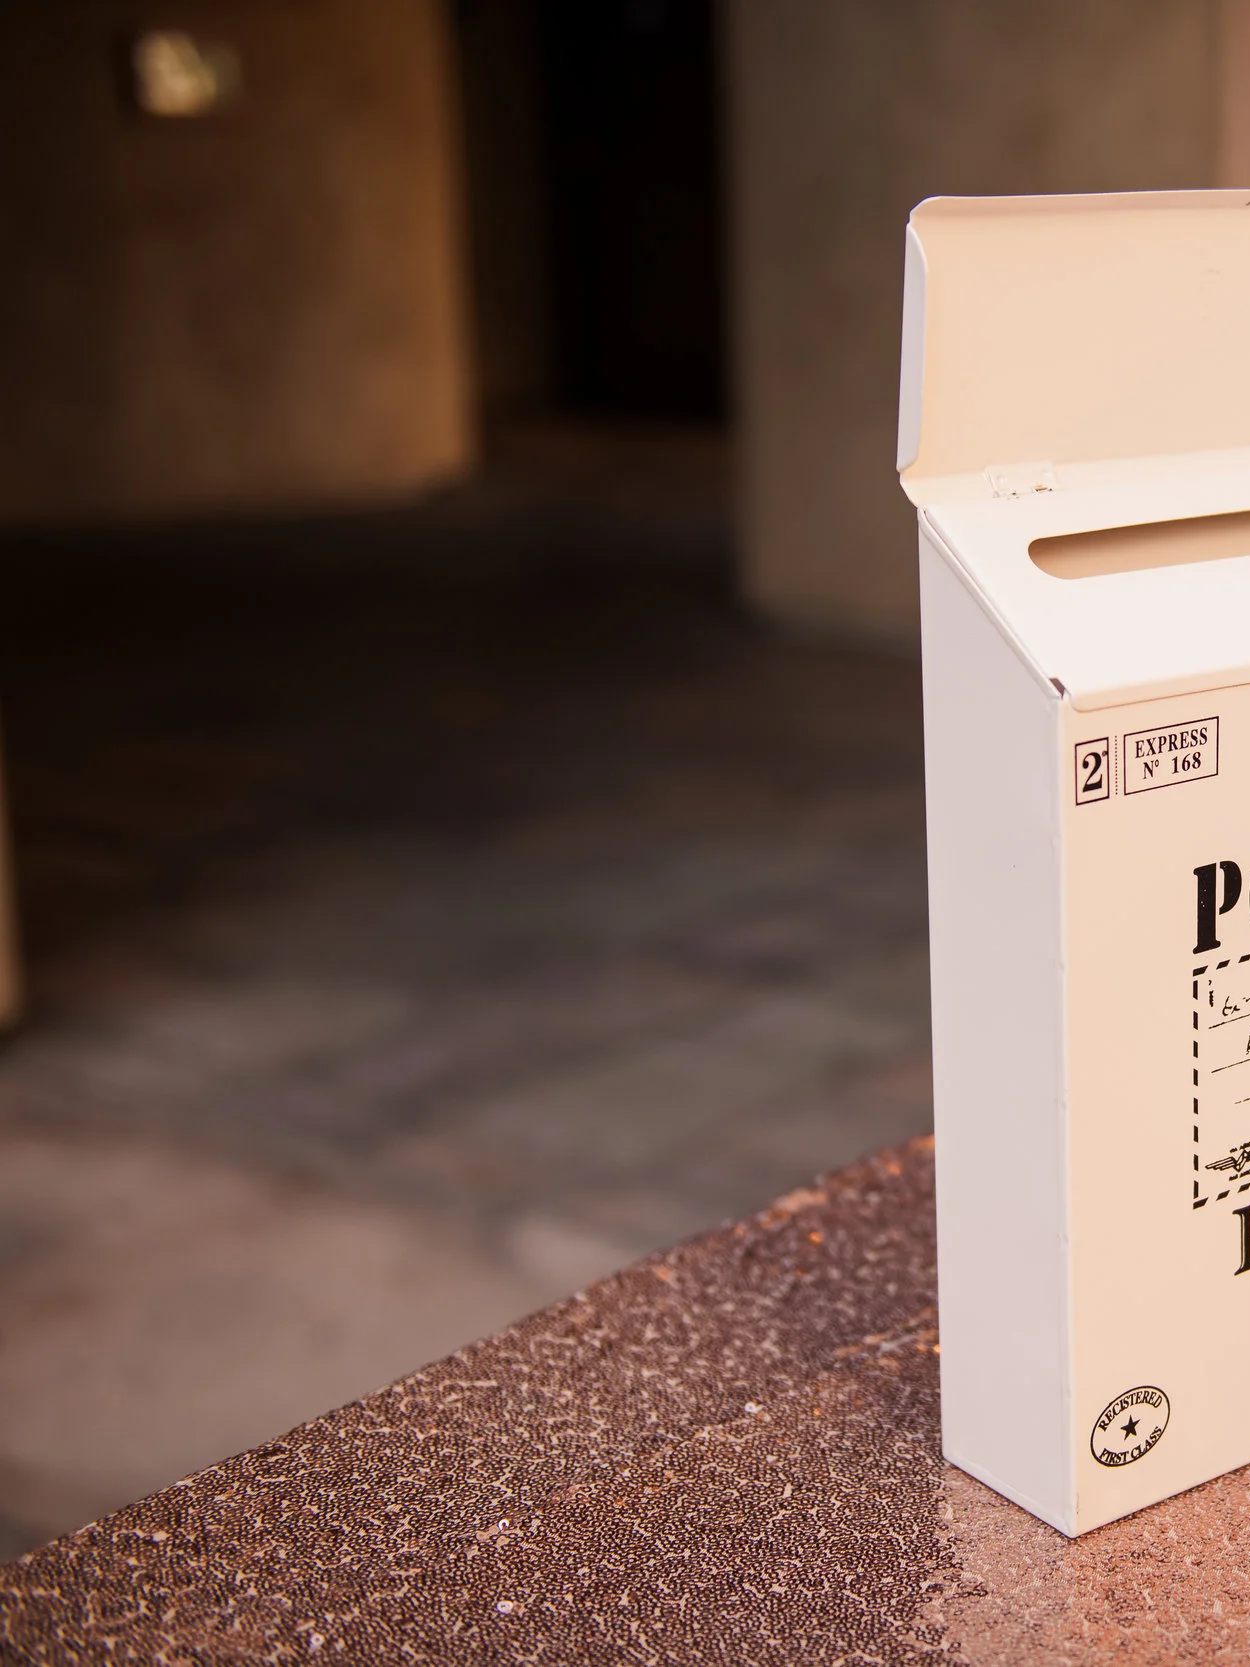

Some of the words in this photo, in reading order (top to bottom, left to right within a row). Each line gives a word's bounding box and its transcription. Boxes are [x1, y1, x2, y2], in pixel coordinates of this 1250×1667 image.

[1135, 726, 1208, 759] EXPRESS
[1171, 751, 1202, 775] 168
[1098, 1390, 1163, 1432] REGISTERED
[1099, 1448, 1130, 1465] FIRST
[1130, 1426, 1162, 1460] CLASS
